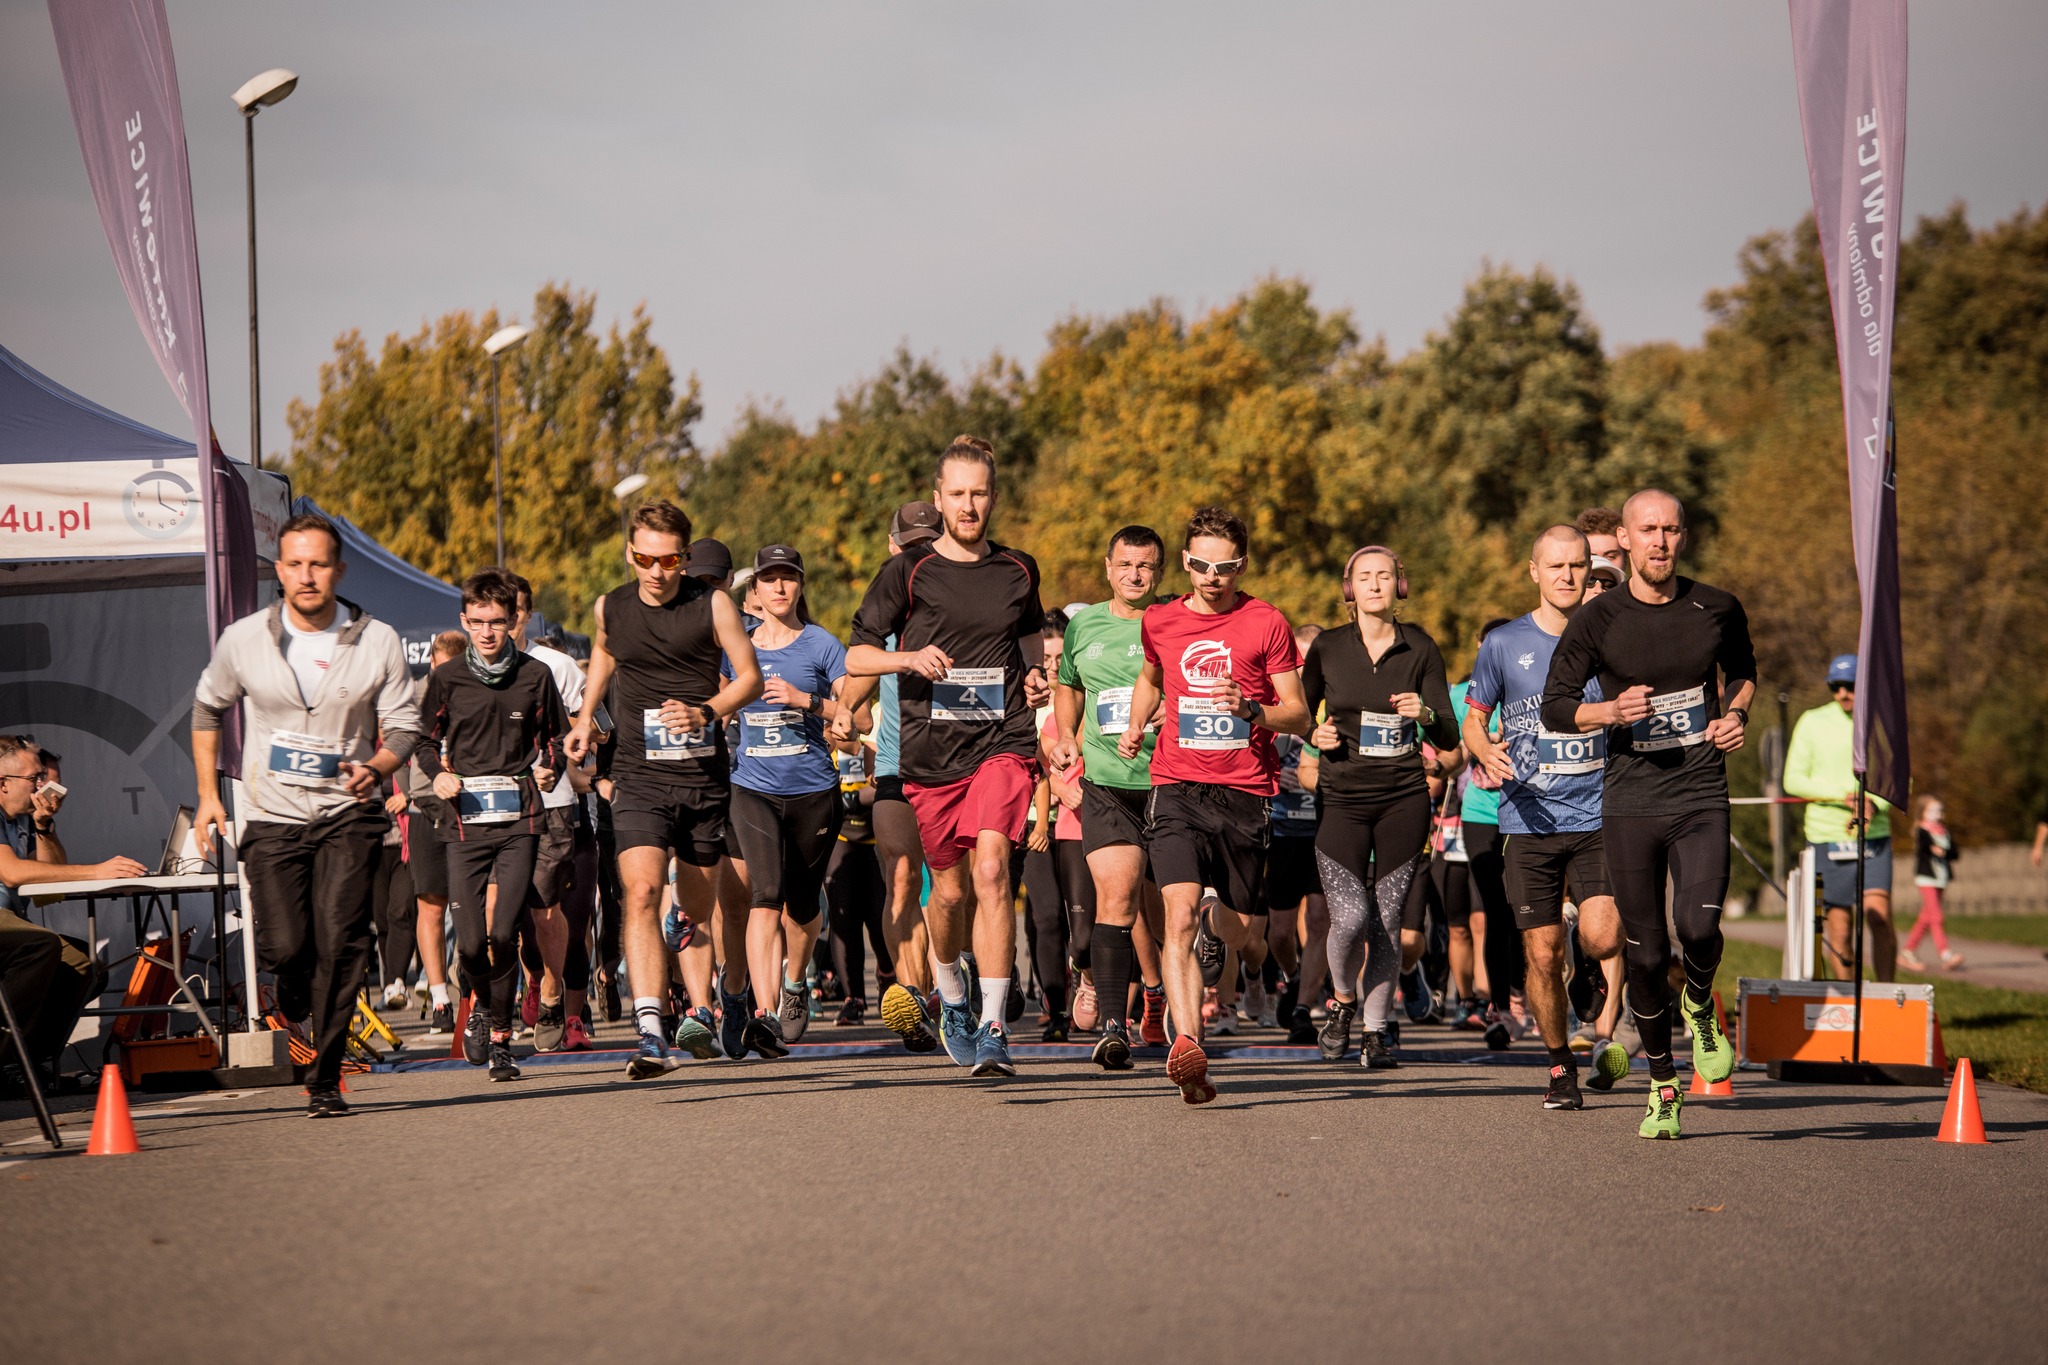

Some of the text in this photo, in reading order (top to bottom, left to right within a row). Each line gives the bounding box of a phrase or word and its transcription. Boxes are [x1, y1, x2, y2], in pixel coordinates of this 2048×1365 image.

[959, 687, 978, 705] 4
[1194, 716, 1234, 735] 30
[1649, 711, 1691, 736] 28
[654, 727, 705, 745] 109
[764, 727, 781, 744] 5
[1377, 729, 1402, 745] 13
[1551, 739, 1594, 760] 101
[286, 751, 322, 773] 12
[482, 792, 494, 809] 1
